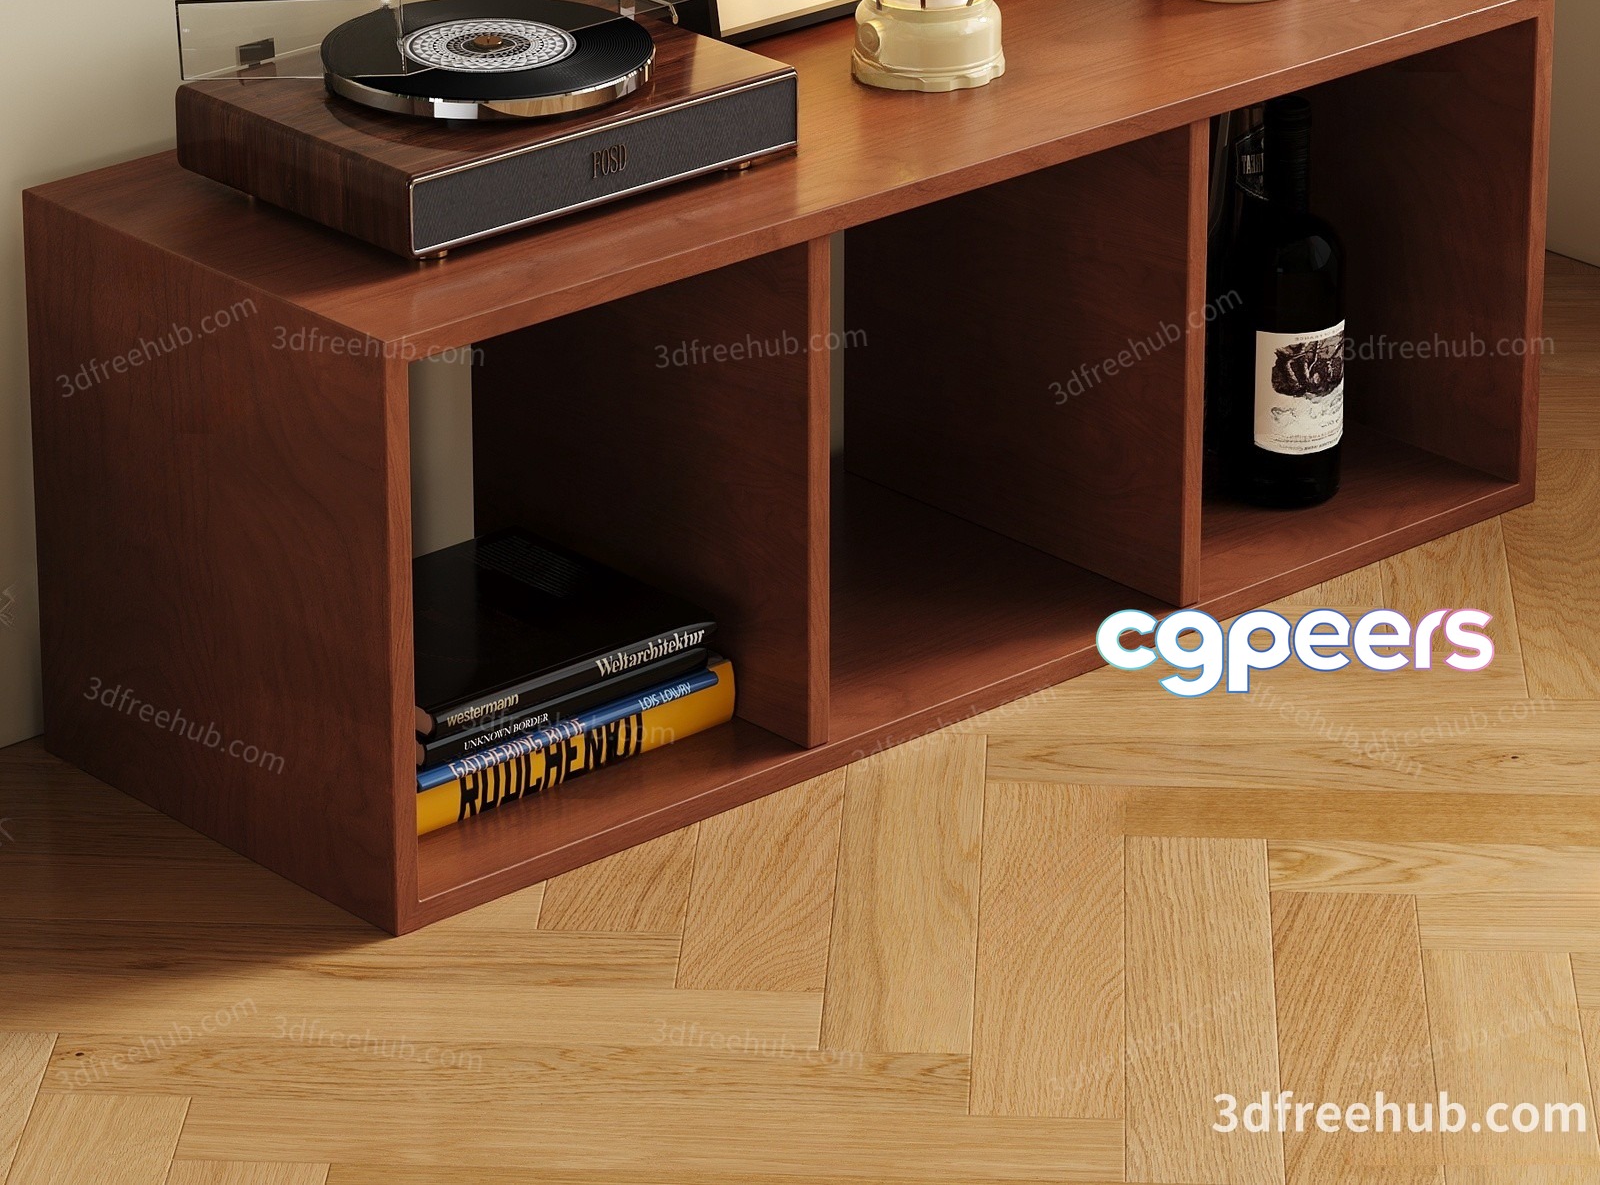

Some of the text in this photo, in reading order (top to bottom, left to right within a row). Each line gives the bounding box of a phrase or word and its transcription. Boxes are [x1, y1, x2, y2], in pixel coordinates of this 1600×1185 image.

[595, 629, 705, 677] Weltarchitektur
[446, 693, 519, 727] westermann
[638, 682, 692, 711] LOIS LOWRY
[464, 713, 548, 750] UNKNOWN BORDER
[448, 734, 543, 778] GATHERING
